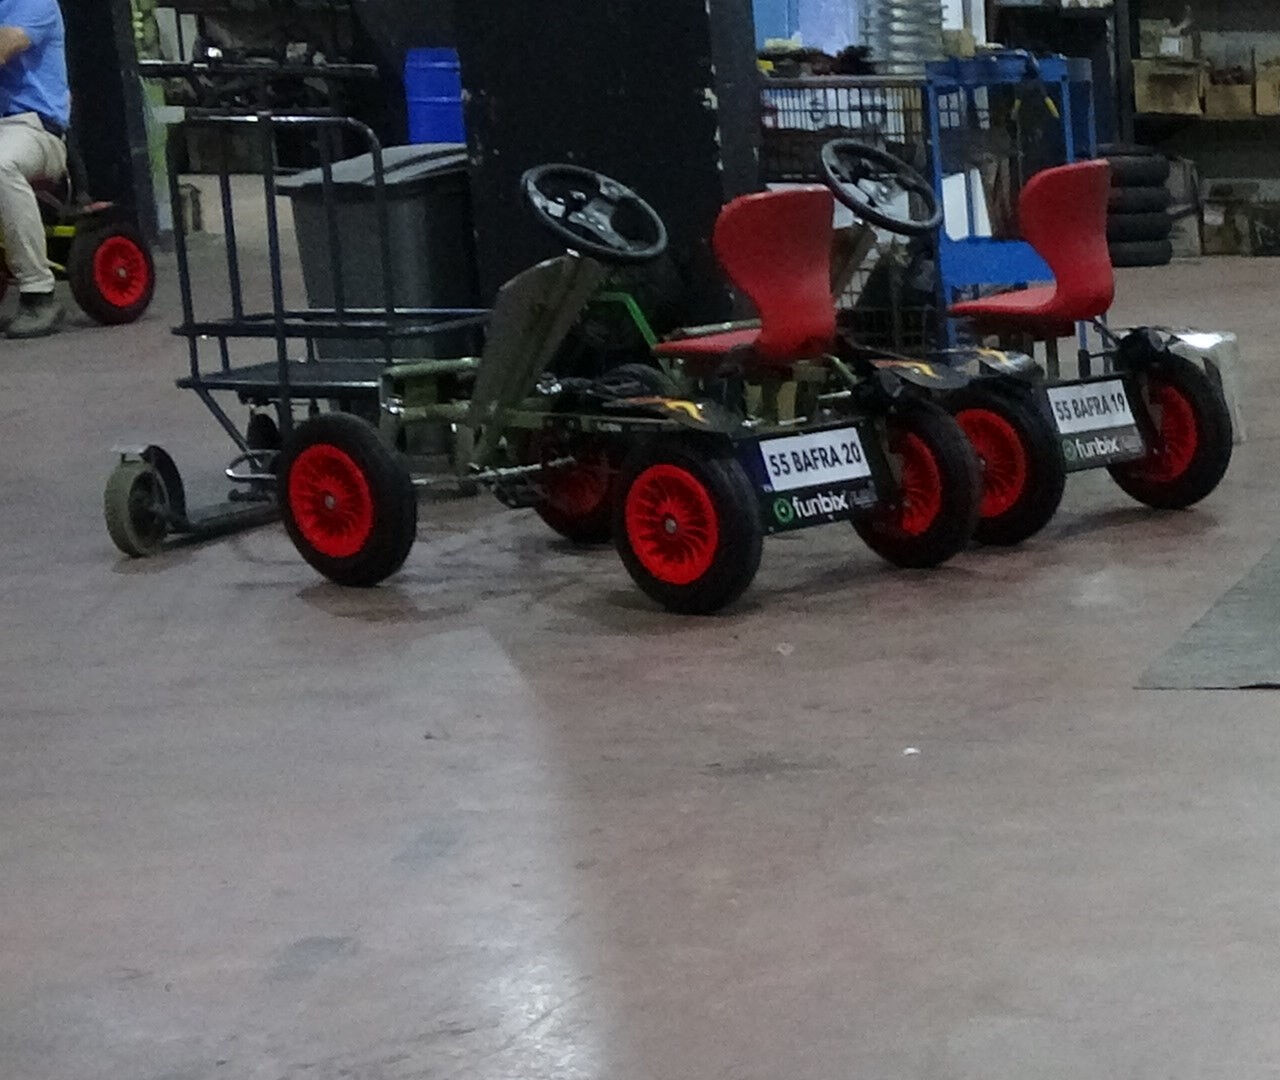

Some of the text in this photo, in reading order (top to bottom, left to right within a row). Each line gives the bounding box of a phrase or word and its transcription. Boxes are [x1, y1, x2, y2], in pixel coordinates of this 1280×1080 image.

[1055, 392, 1125, 421] 55 BAFRA 19
[769, 442, 862, 477] 55 BAFRA 20
[792, 490, 849, 518] funbix
